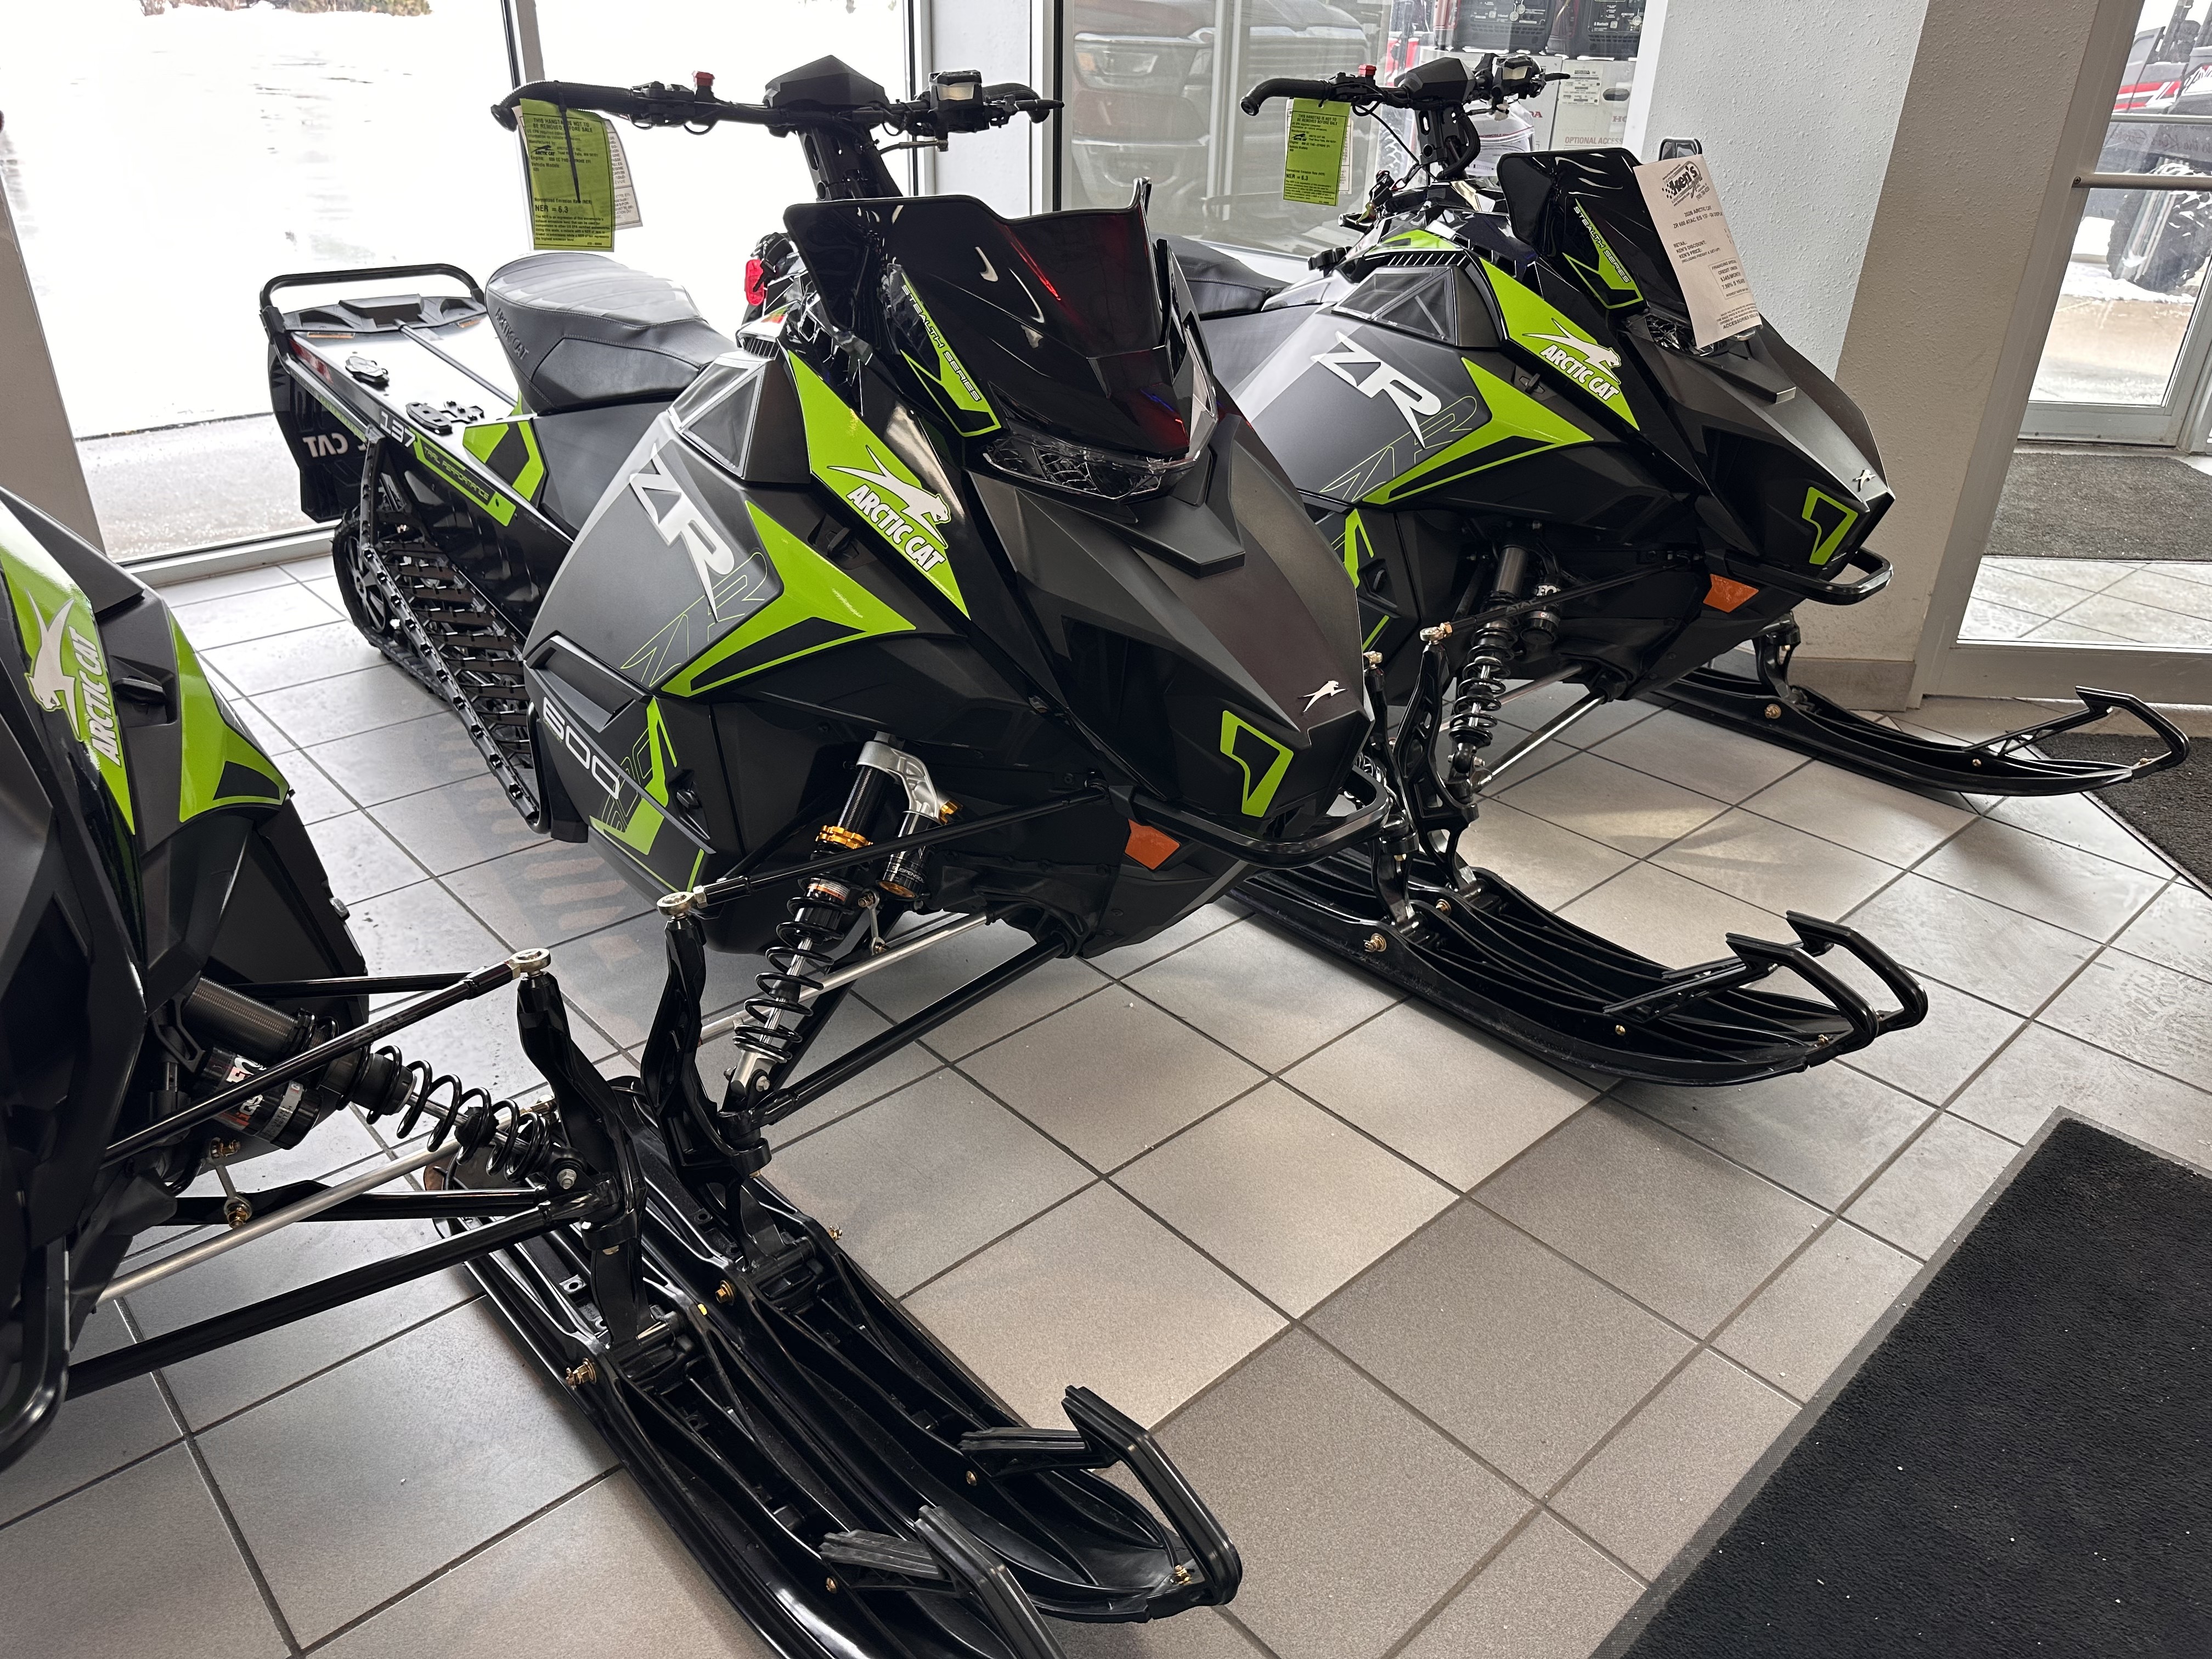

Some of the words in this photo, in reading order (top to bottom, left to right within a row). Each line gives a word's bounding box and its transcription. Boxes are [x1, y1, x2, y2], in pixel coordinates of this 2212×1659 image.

[1669, 166, 1697, 196] ken's
[1573, 206, 1605, 248] STEALTH
[1603, 249, 1630, 283] SERIES
[1686, 217, 1696, 226] ATAC
[512, 337, 529, 360] CAT
[901, 284, 945, 348] STEALTH
[943, 351, 982, 402] SERIES
[1723, 315, 1749, 329] ACCESSORIES
[1311, 330, 1442, 449] ZR
[1539, 344, 1594, 383] ARCTIC
[1588, 376, 1620, 401] CAT
[380, 411, 416, 448] 137
[424, 447, 441, 464] TRAIL
[442, 460, 489, 501] PERFORMANCE
[629, 444, 736, 622] ZR
[846, 483, 915, 545] ARCTIC
[905, 535, 946, 572] CAT
[68, 625, 103, 676] CAT
[78, 670, 122, 768] ARCTIC
[543, 697, 620, 799] 600
[226, 1054, 267, 1083] FO
